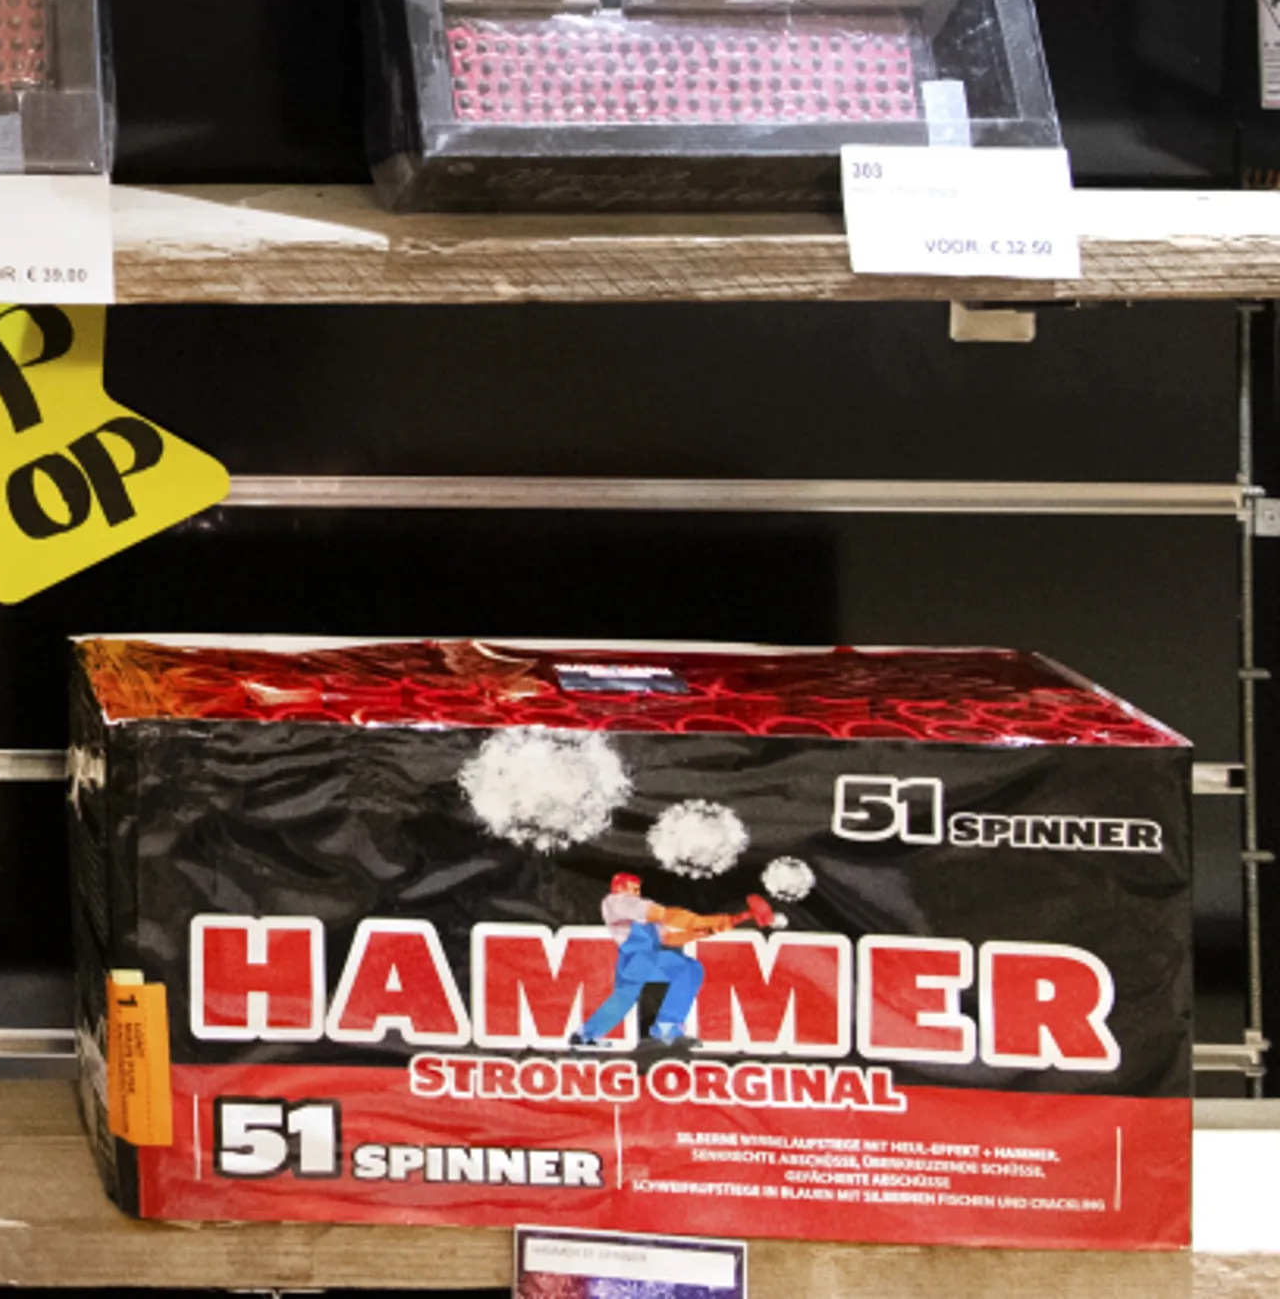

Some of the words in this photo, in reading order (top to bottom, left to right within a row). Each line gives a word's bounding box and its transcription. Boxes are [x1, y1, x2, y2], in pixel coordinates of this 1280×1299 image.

[6, 416, 164, 540] OP
[832, 774, 943, 843] 51
[948, 812, 1163, 854] SPINNER
[190, 914, 1121, 1071] HAMMER
[410, 1055, 639, 1100] STRONG
[647, 1061, 907, 1113] ORGINAL
[213, 1098, 339, 1178] 51
[353, 1145, 604, 1188] SPINNER
